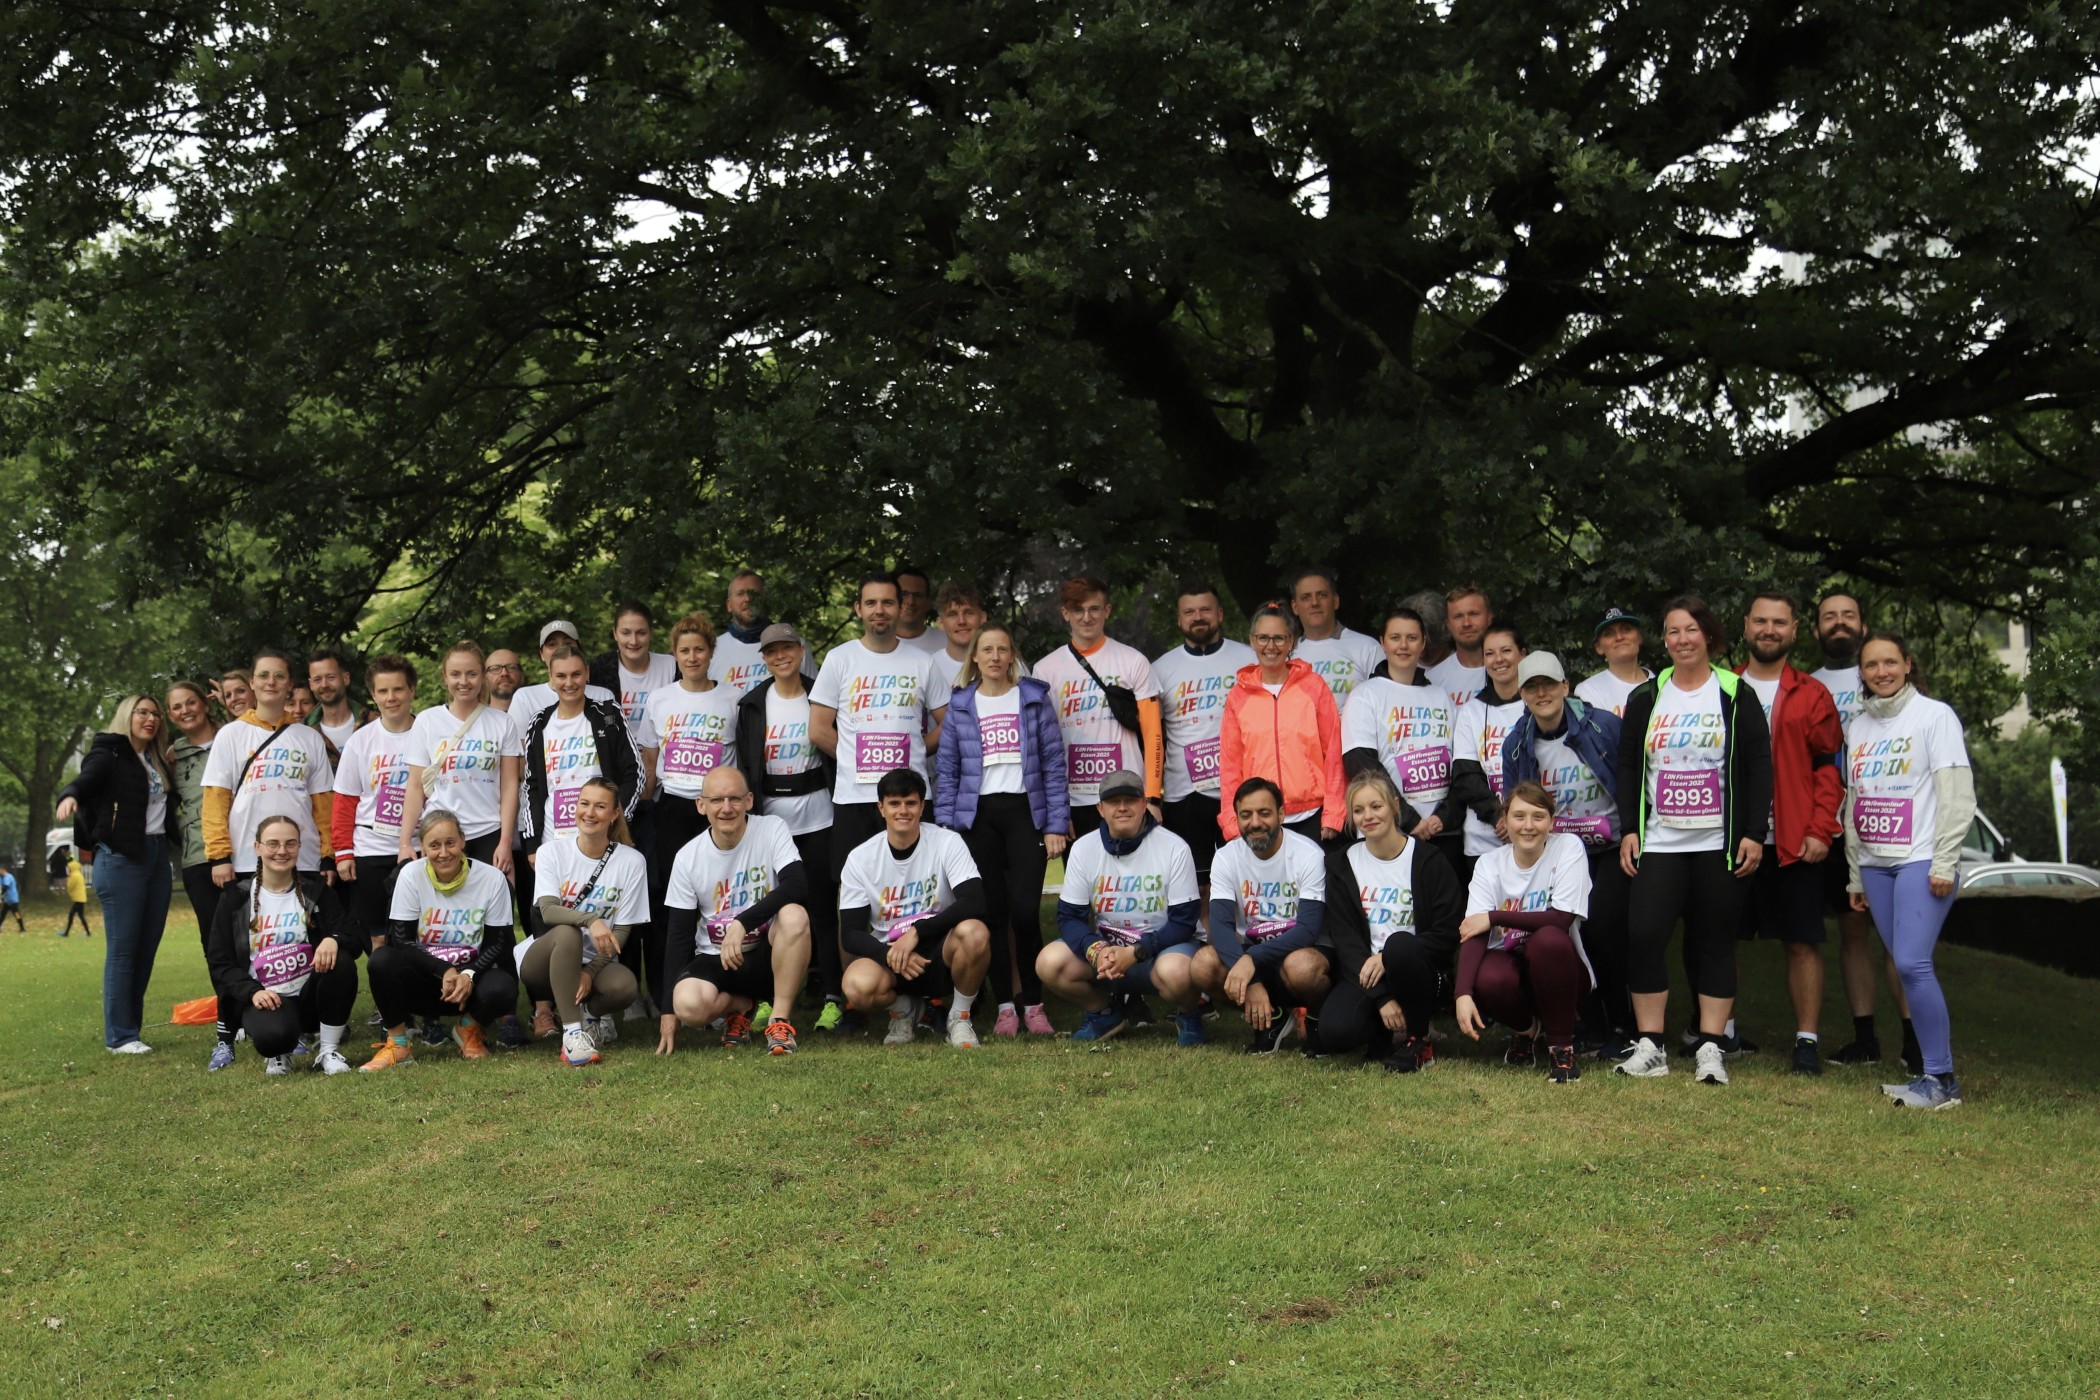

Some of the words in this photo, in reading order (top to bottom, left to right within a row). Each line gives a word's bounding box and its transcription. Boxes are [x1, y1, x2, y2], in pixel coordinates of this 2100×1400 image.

[723, 664, 768, 686] ALLTA
[1314, 660, 1355, 676] TAGS
[849, 674, 917, 695] ALLTAGS
[1175, 675, 1235, 700] ALLTAG
[849, 692, 918, 714] HELD:IN
[1059, 695, 1109, 719] HELD:I
[1176, 694, 1228, 718] HELD:
[663, 713, 727, 732] ALLTAGS
[1388, 706, 1449, 725] ALLTAGS
[1649, 713, 1723, 732] ALLTAGS
[1388, 722, 1452, 745] HELD:IN
[1647, 732, 1724, 754] HELD:IN
[545, 735, 597, 755] ALLTAG
[1416, 749, 1444, 758] Firmenlauf
[1852, 736, 1912, 762] ALLTAGS
[670, 749, 714, 769] 3006
[862, 748, 905, 764] 2982
[1192, 753, 1220, 773] 300
[1427, 755, 1441, 763] 2025
[1075, 759, 1117, 775] 3003
[1407, 762, 1447, 784] 3019
[1542, 765, 1597, 787] LLTAG
[1676, 772, 1711, 780] Firmenlauf
[1688, 779, 1704, 787] 2025
[1662, 787, 1713, 806] 2993
[1870, 800, 1905, 808] Firmenlauf
[381, 801, 403, 818] 29
[558, 803, 577, 820] 29
[1568, 819, 1602, 827] Firmenlauf
[1858, 815, 1904, 834] 2987
[1581, 833, 1606, 845] 96
[1092, 874, 1163, 895] ALLTAGS
[1240, 879, 1298, 899] ALLTAGS
[1091, 894, 1166, 914] HELD:IN
[1360, 886, 1413, 905] LLTAG
[1500, 889, 1552, 912] ALLTA
[420, 907, 485, 927] ALLTAG
[1258, 926, 1274, 934] Essen
[1274, 922, 1287, 930] 2025
[263, 952, 308, 979] 2999
